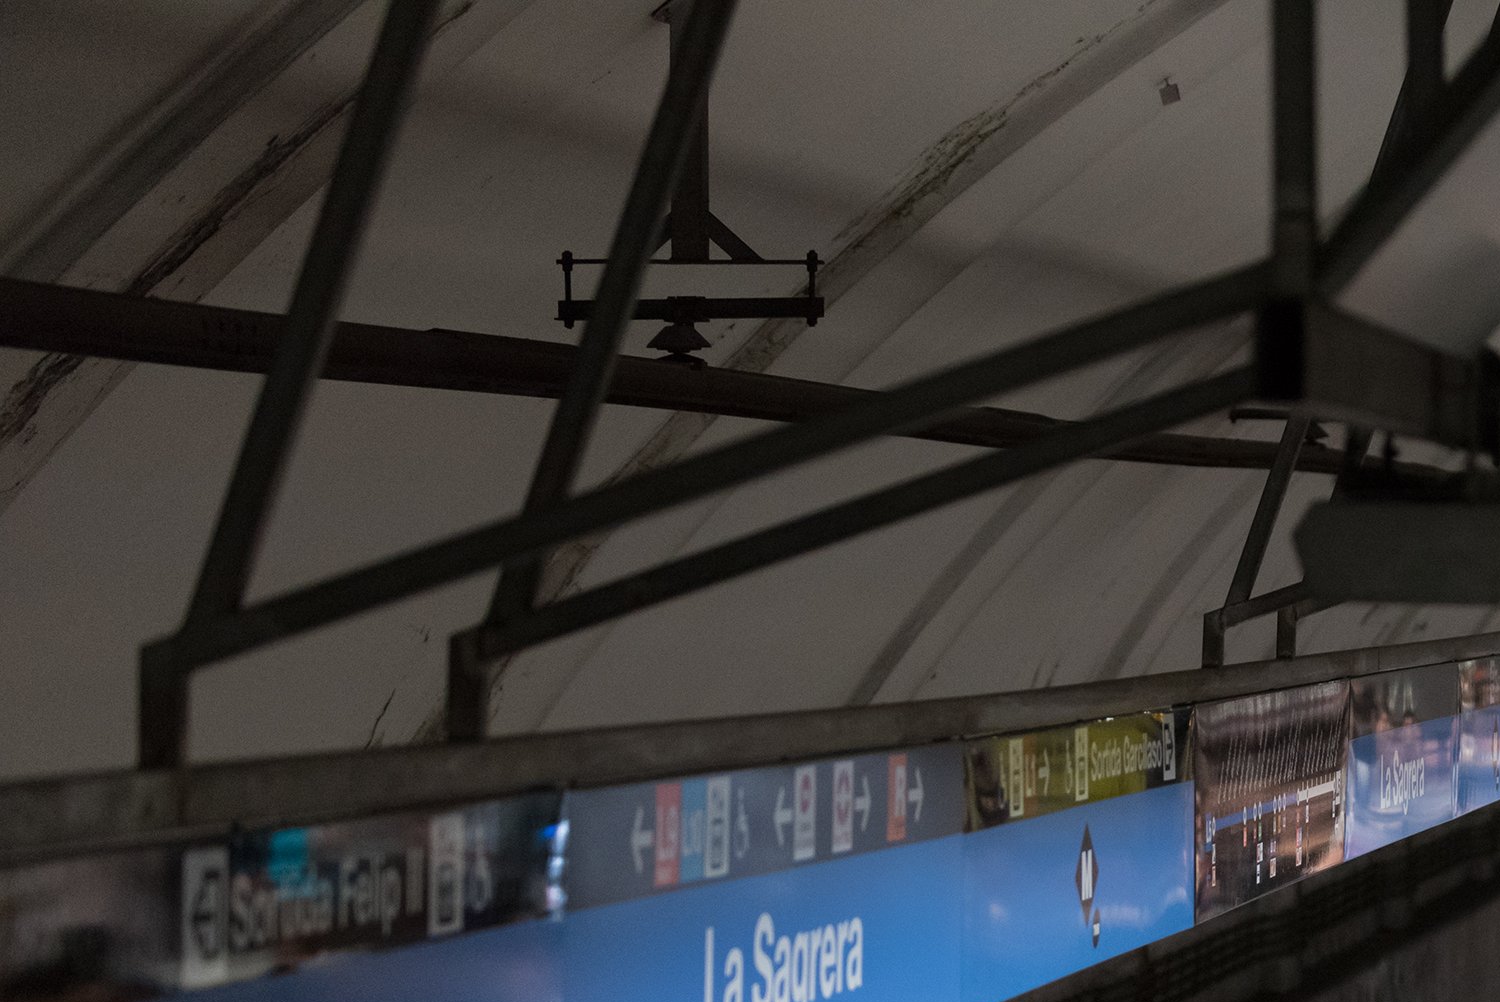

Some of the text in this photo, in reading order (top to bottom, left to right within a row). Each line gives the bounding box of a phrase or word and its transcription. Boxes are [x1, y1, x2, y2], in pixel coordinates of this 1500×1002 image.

[1091, 738, 1122, 782] Sortida
[1380, 754, 1392, 810] La
[1392, 750, 1425, 816] Sagrera
